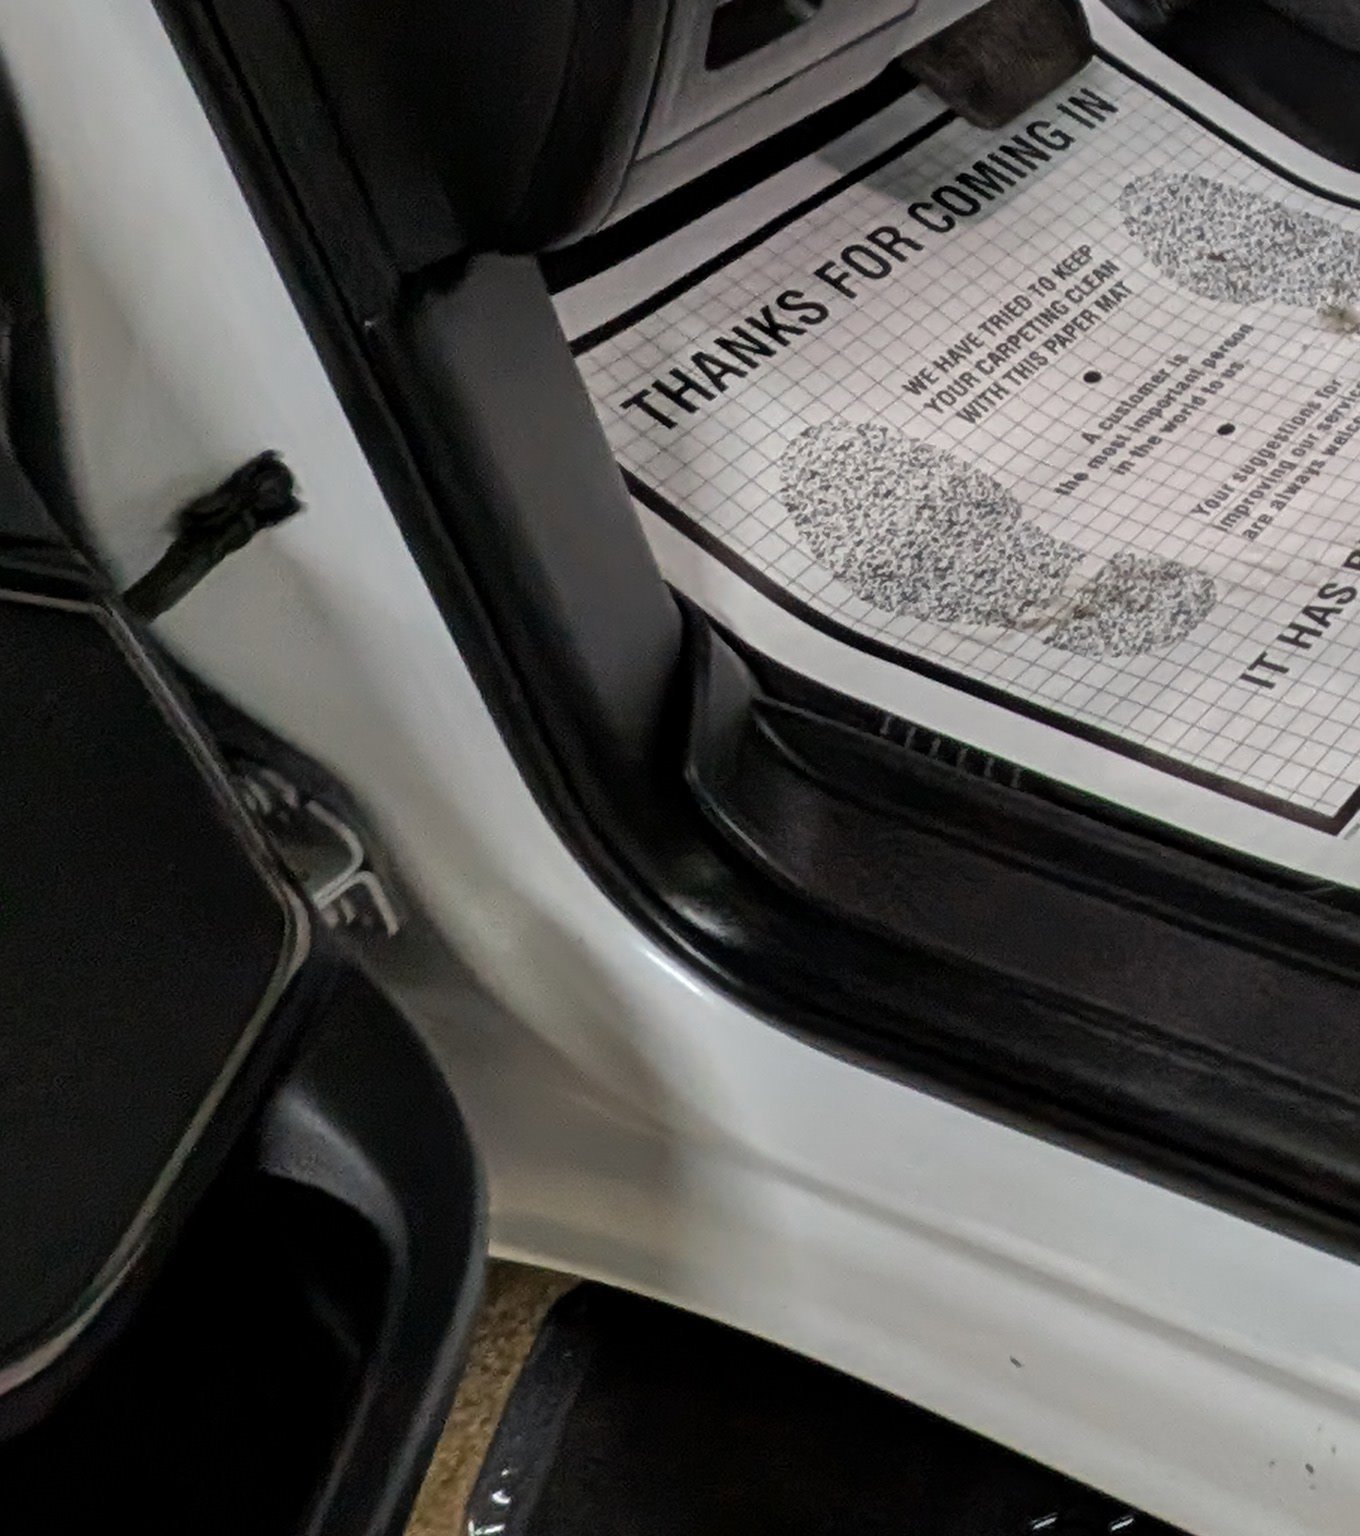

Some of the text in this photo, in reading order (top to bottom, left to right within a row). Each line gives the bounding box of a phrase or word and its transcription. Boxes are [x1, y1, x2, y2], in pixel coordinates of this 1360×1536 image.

[620, 88, 1119, 429] THANKS FOR COMING IN
[902, 244, 1093, 395] WE HAVE TRIED TO KEEP
[923, 259, 1121, 414] YOUR CARPETING CLEAN
[955, 382, 1010, 424] WITH
[1002, 351, 1049, 387] THIS
[1042, 308, 1099, 355] PAPER
[1054, 323, 1254, 495] the most important person
[1081, 354, 1190, 445] A customer is
[1110, 459, 1135, 476] in
[1129, 435, 1163, 458] the
[1159, 394, 1207, 433] world
[1201, 380, 1225, 395] to
[1191, 379, 1343, 516] Your suggestions for
[1291, 432, 1320, 457] our
[1242, 512, 1274, 542] are
[1270, 459, 1327, 511] always
[1239, 651, 1290, 690] IT
[1276, 582, 1358, 649] HAS
